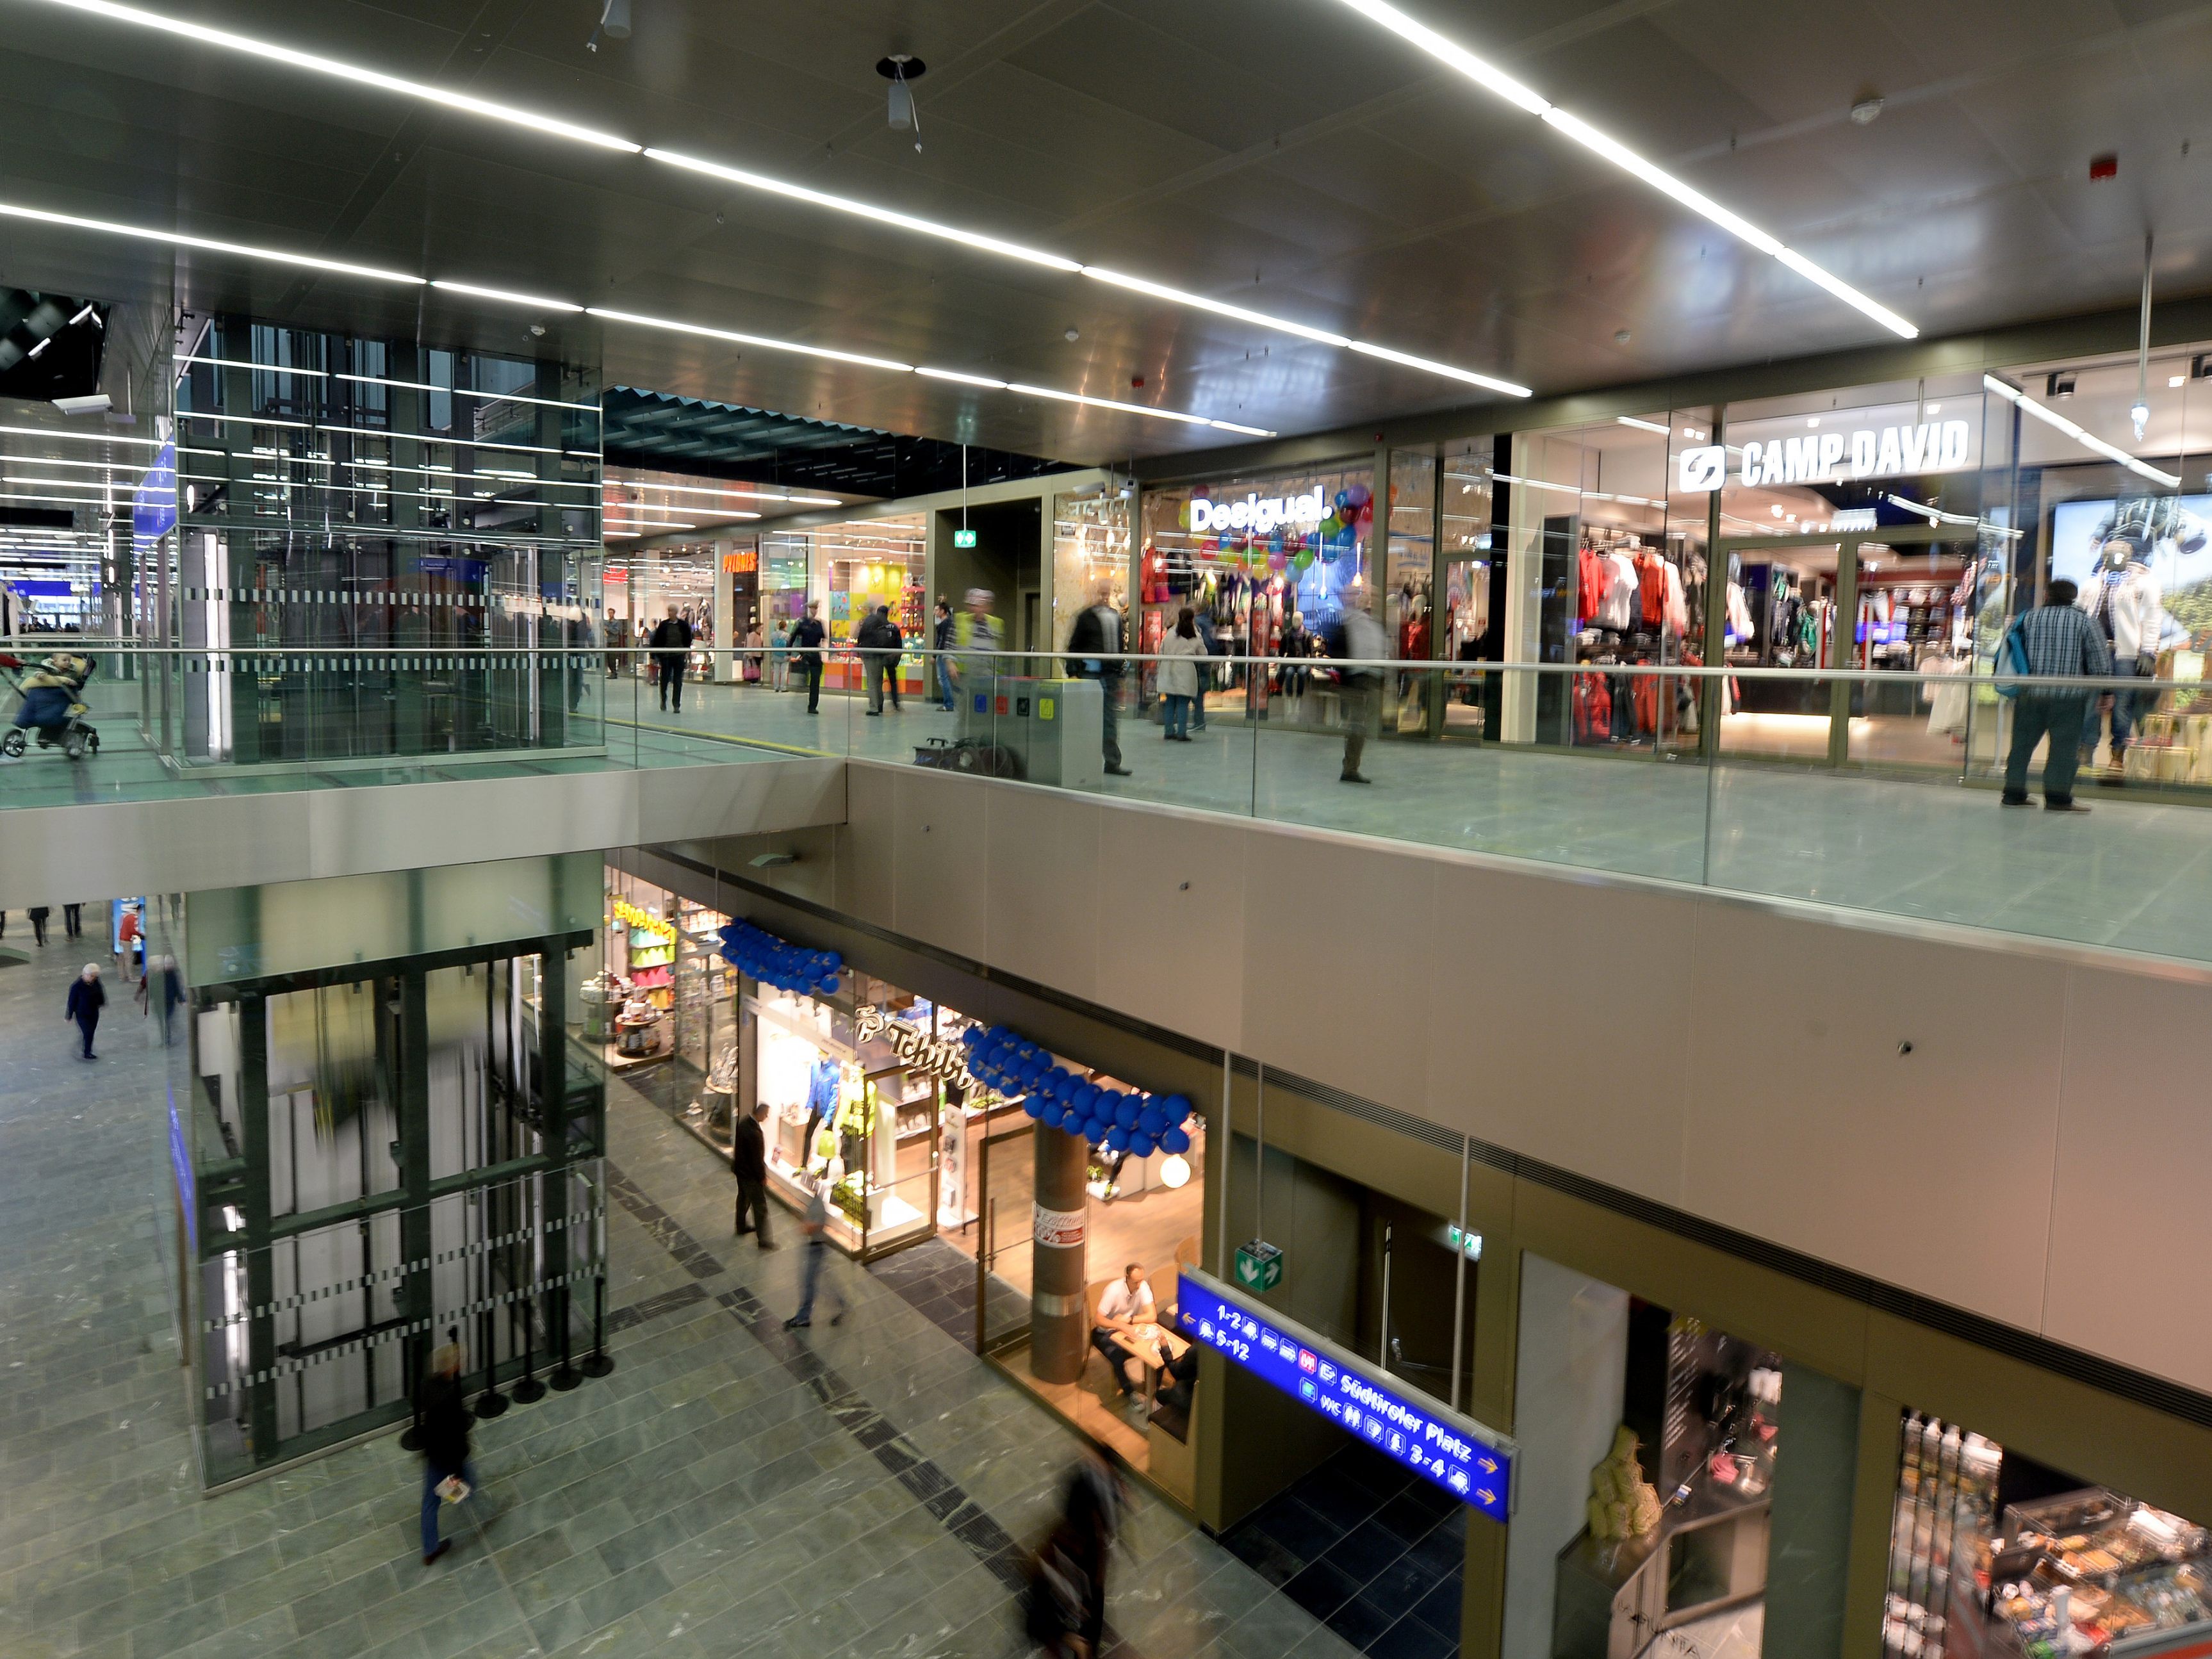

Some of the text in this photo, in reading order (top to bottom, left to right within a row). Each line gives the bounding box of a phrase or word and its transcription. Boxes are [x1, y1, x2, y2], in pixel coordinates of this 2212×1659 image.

[1741, 420, 1969, 487] CAMP DAVID
[723, 552, 757, 573] PYLONES
[1217, 1305, 1241, 1330] 1-2
[1216, 1329, 1250, 1362] 5-12
[1320, 1394, 1341, 1417] WC
[1340, 1375, 1423, 1434] Südtiroler
[1425, 1422, 1472, 1464] Platz
